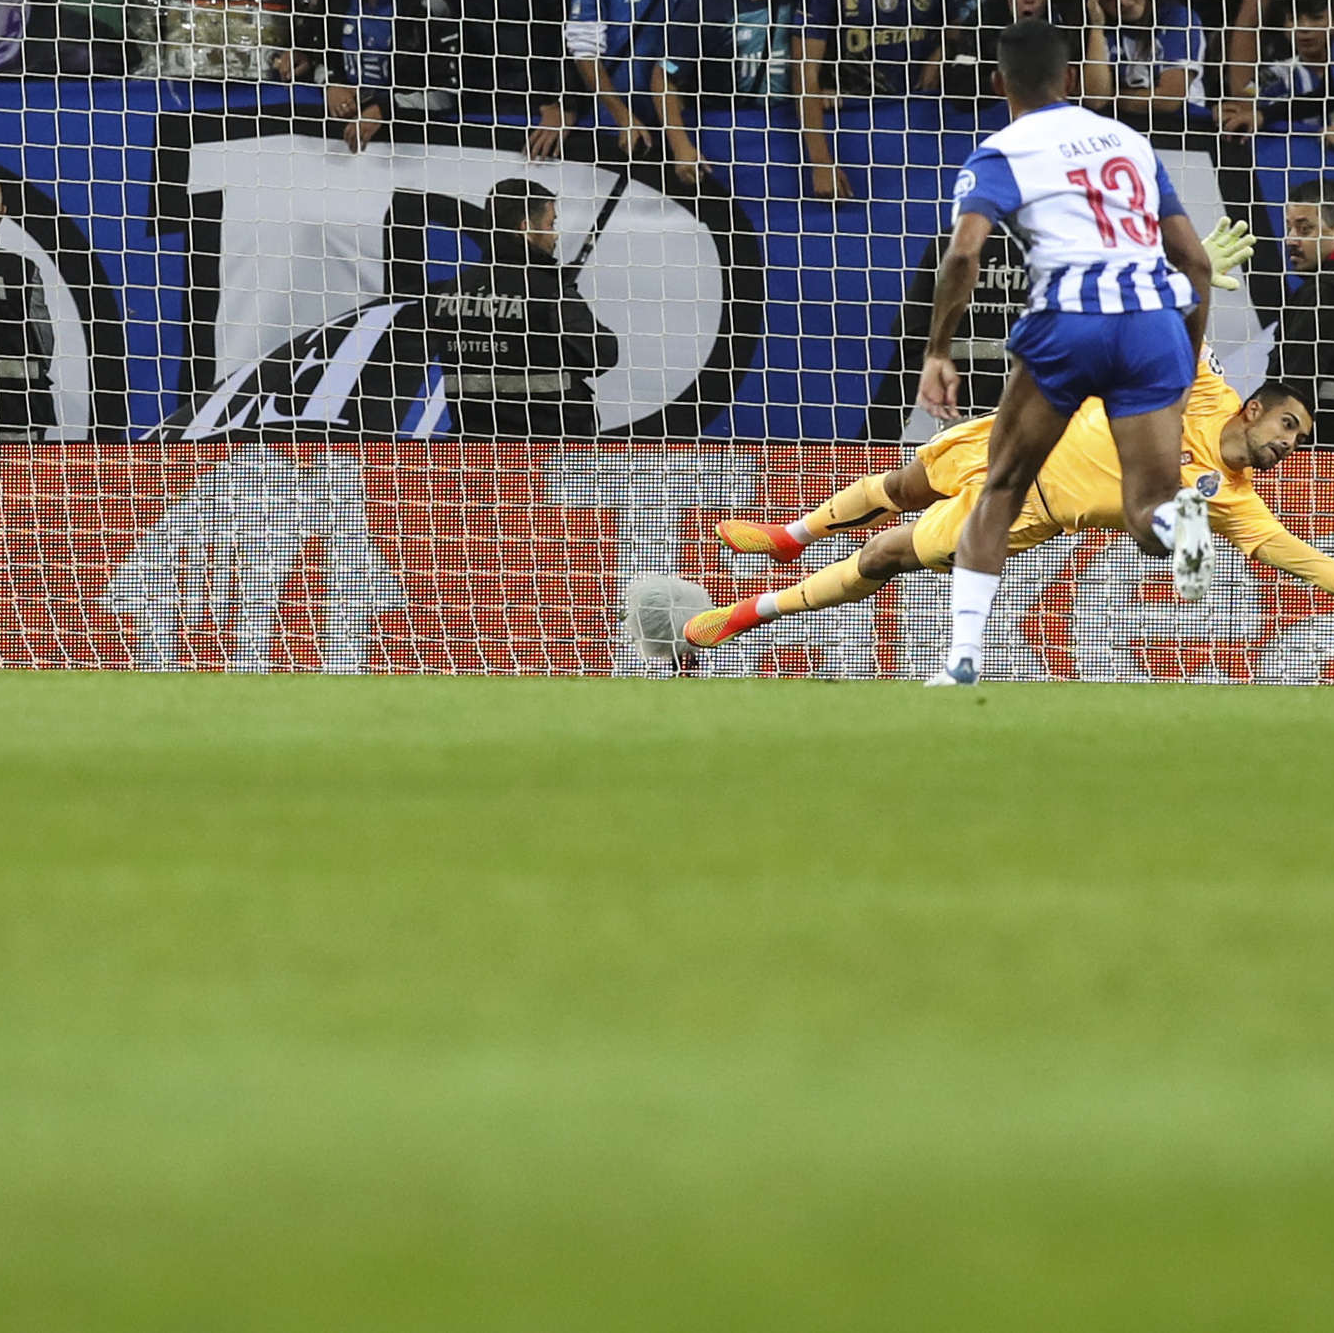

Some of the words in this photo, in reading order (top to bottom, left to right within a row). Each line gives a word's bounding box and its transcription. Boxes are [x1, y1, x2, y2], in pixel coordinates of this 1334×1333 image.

[874, 27, 926, 46] BETAN
[1059, 133, 1122, 159] GALENO
[1067, 155, 1159, 249] 13
[434, 287, 524, 321] POLÍCIA
